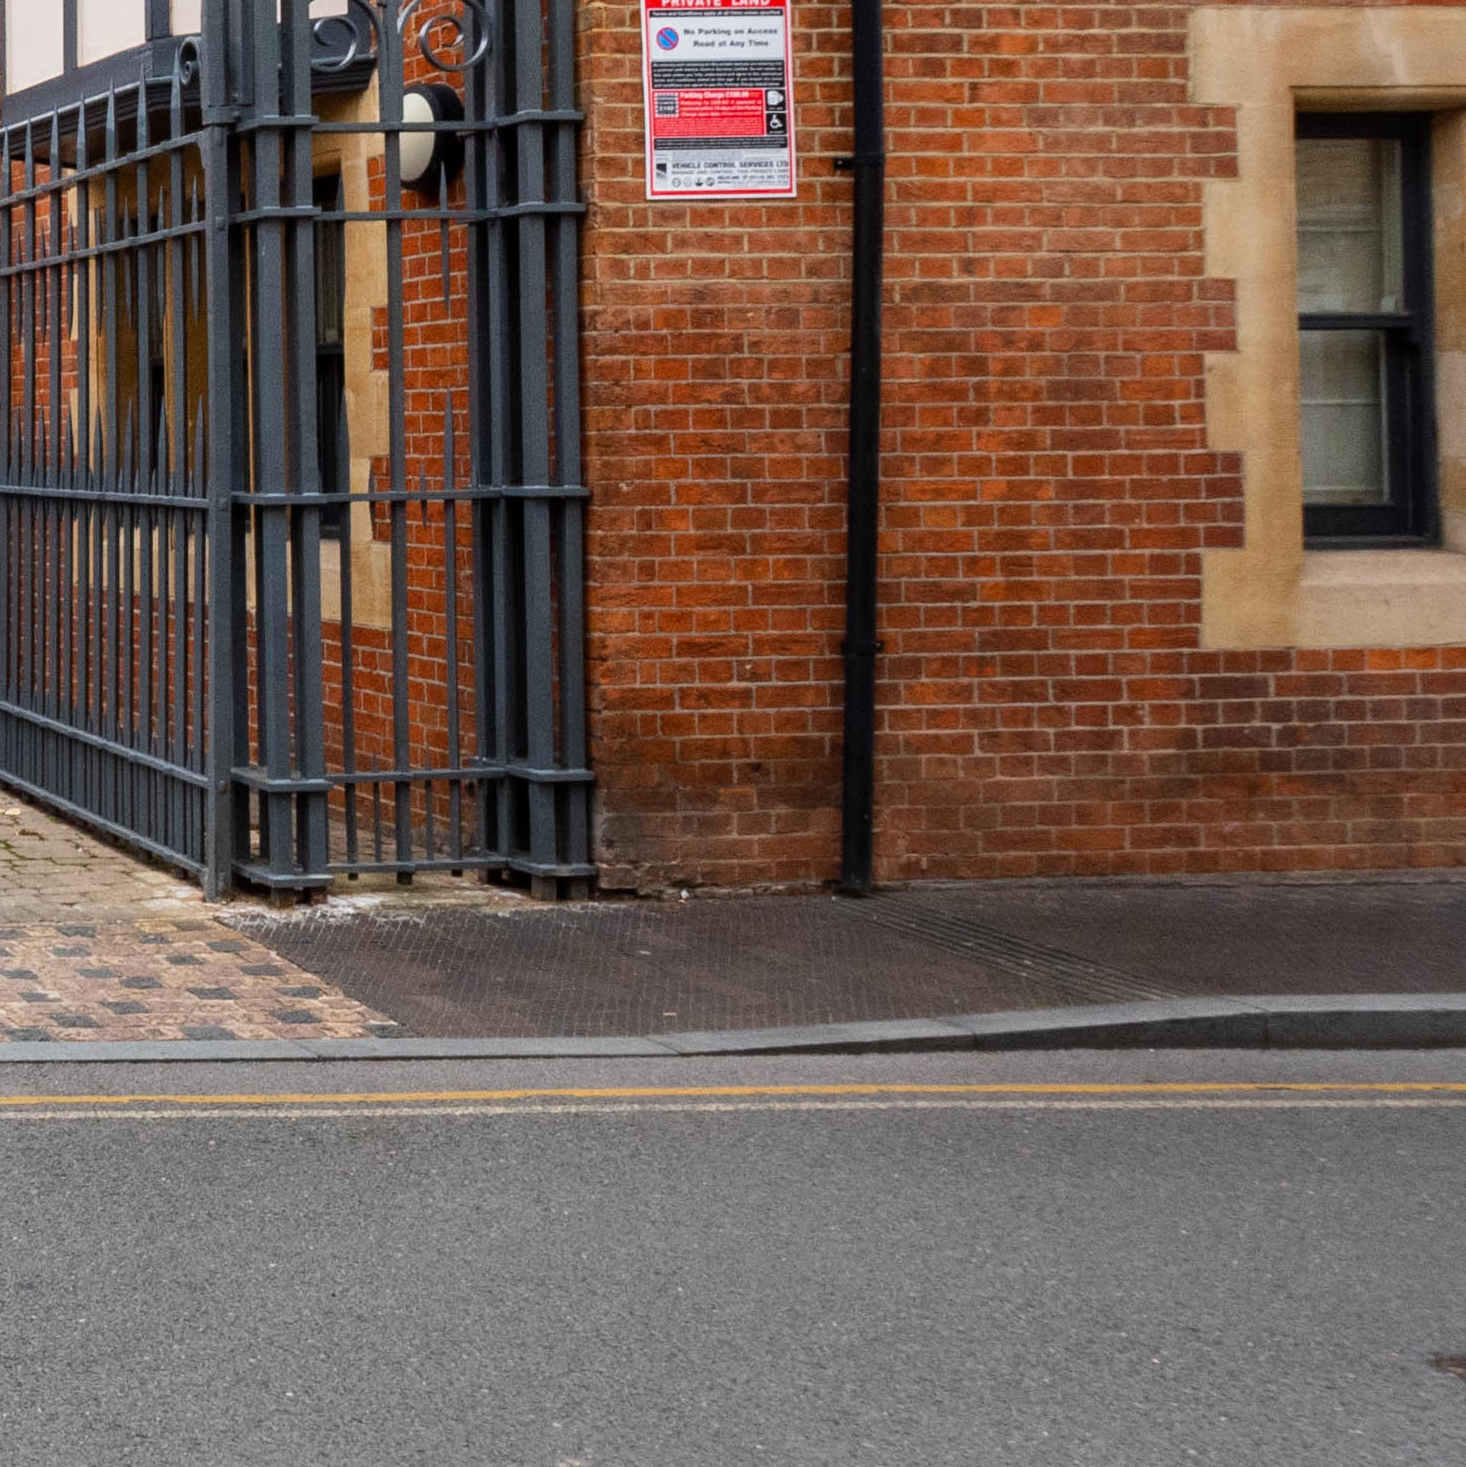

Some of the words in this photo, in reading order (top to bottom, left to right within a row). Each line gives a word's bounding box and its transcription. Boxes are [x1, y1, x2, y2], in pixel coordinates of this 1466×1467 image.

[697, 28, 731, 36] Parking
[747, 27, 778, 35] Access
[729, 40, 746, 48] Any
